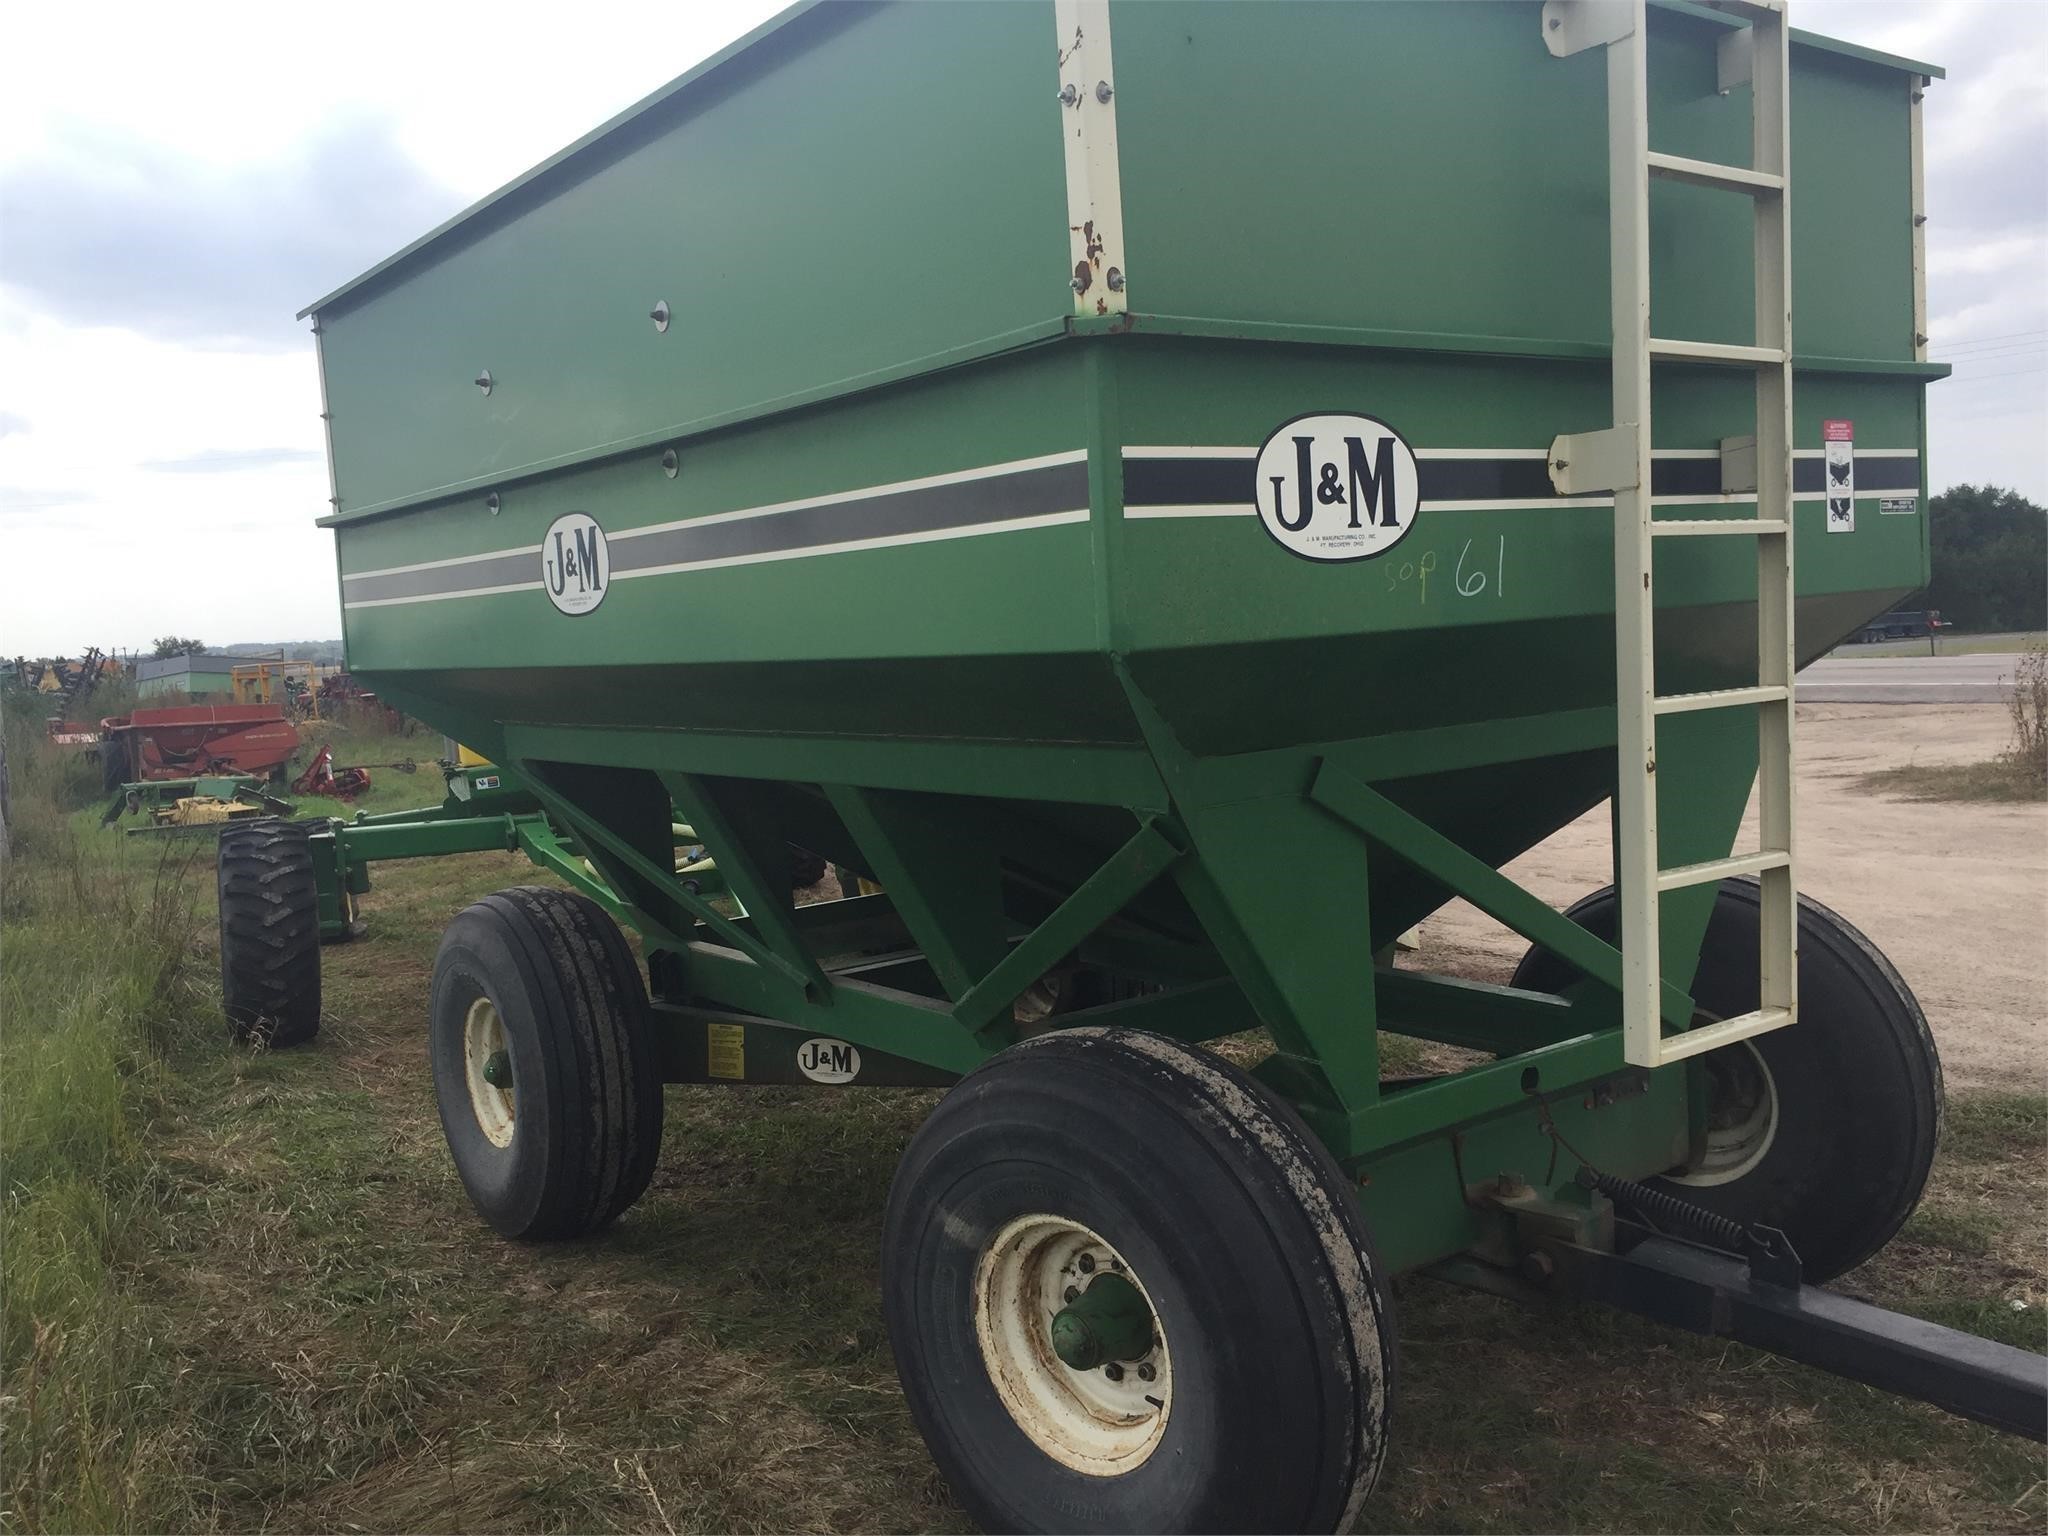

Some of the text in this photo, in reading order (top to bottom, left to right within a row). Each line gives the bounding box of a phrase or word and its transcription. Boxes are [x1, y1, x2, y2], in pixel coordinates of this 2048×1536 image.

[1269, 436, 1400, 532] J&M
[547, 525, 602, 596] J&M
[1455, 534, 1504, 597] 61
[801, 1043, 853, 1073] J&M
